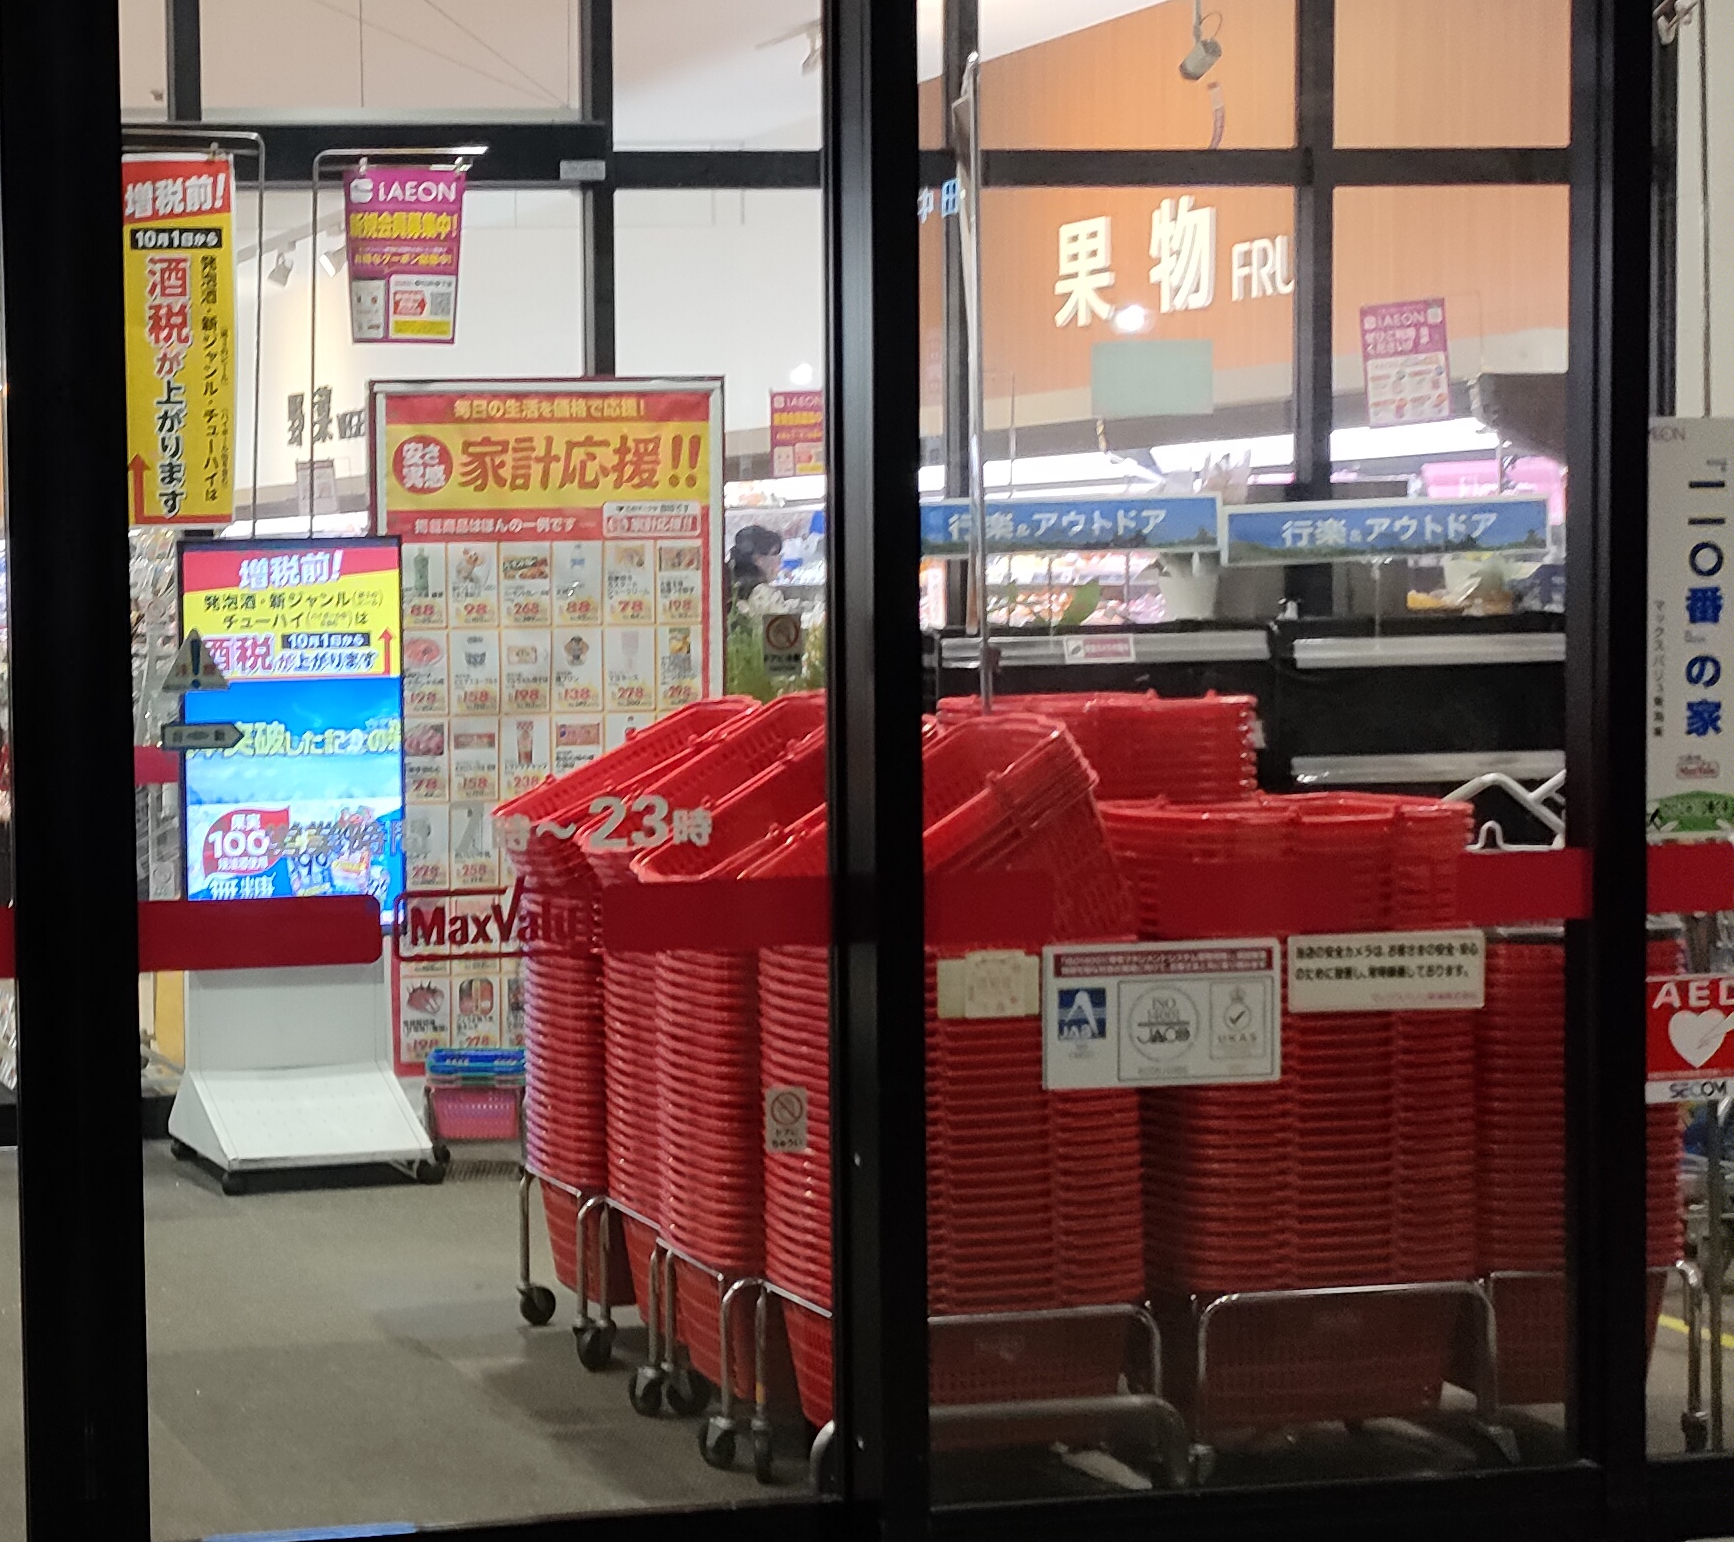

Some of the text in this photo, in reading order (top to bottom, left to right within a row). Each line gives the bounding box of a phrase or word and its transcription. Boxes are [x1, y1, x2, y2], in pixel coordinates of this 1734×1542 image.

[124, 173, 227, 219] 増税前!
[377, 181, 457, 202] iAEON
[135, 229, 219, 249] 10月1日から
[1053, 195, 1217, 328] 果物
[146, 253, 193, 517] 酒税が上がります
[458, 432, 703, 493] 家計応援!!
[238, 549, 344, 590] 増税前!
[207, 829, 271, 859] 100
